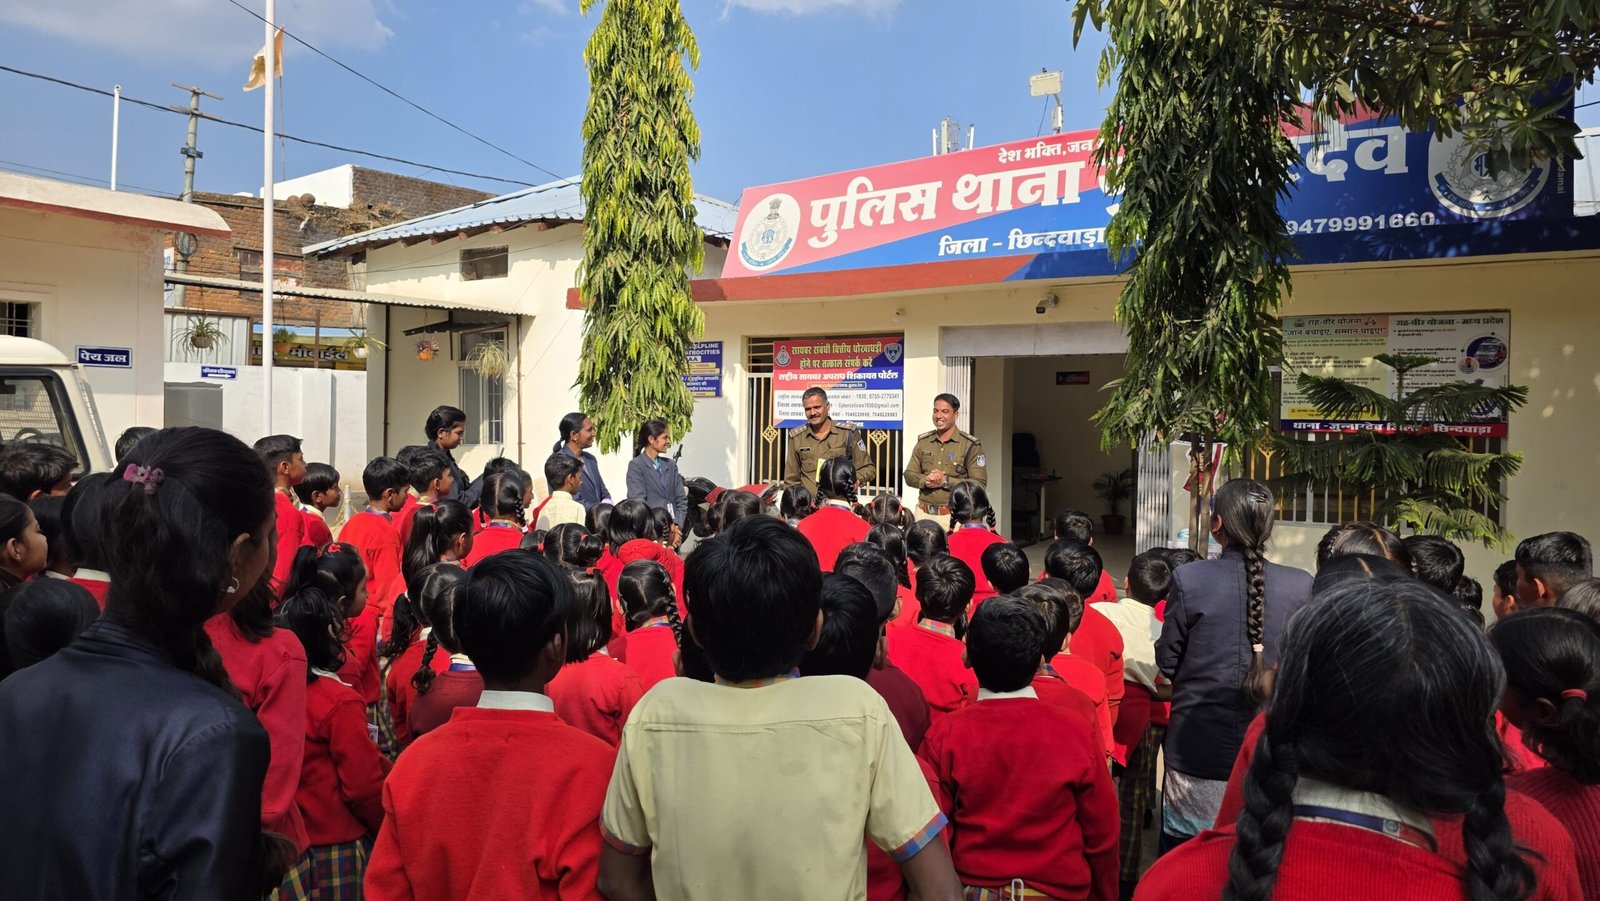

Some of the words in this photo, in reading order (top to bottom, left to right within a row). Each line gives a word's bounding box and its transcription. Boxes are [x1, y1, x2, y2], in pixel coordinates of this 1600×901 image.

[999, 147, 1021, 166] देश
[809, 177, 942, 249] पुलिस
[951, 161, 1086, 214] थाना
[1287, 211, 1436, 235] 9479991660
[938, 236, 988, 256] जिला
[1007, 227, 1108, 250] छिन्दवाड़ा
[1337, 317, 1361, 325] योजना
[1427, 315, 1454, 325] योजना
[80, 350, 102, 361] पेय
[103, 353, 127, 362] जल
[846, 371, 877, 380] शिकायत
[878, 369, 899, 380] पोर्टल
[1293, 422, 1321, 432] थाना
